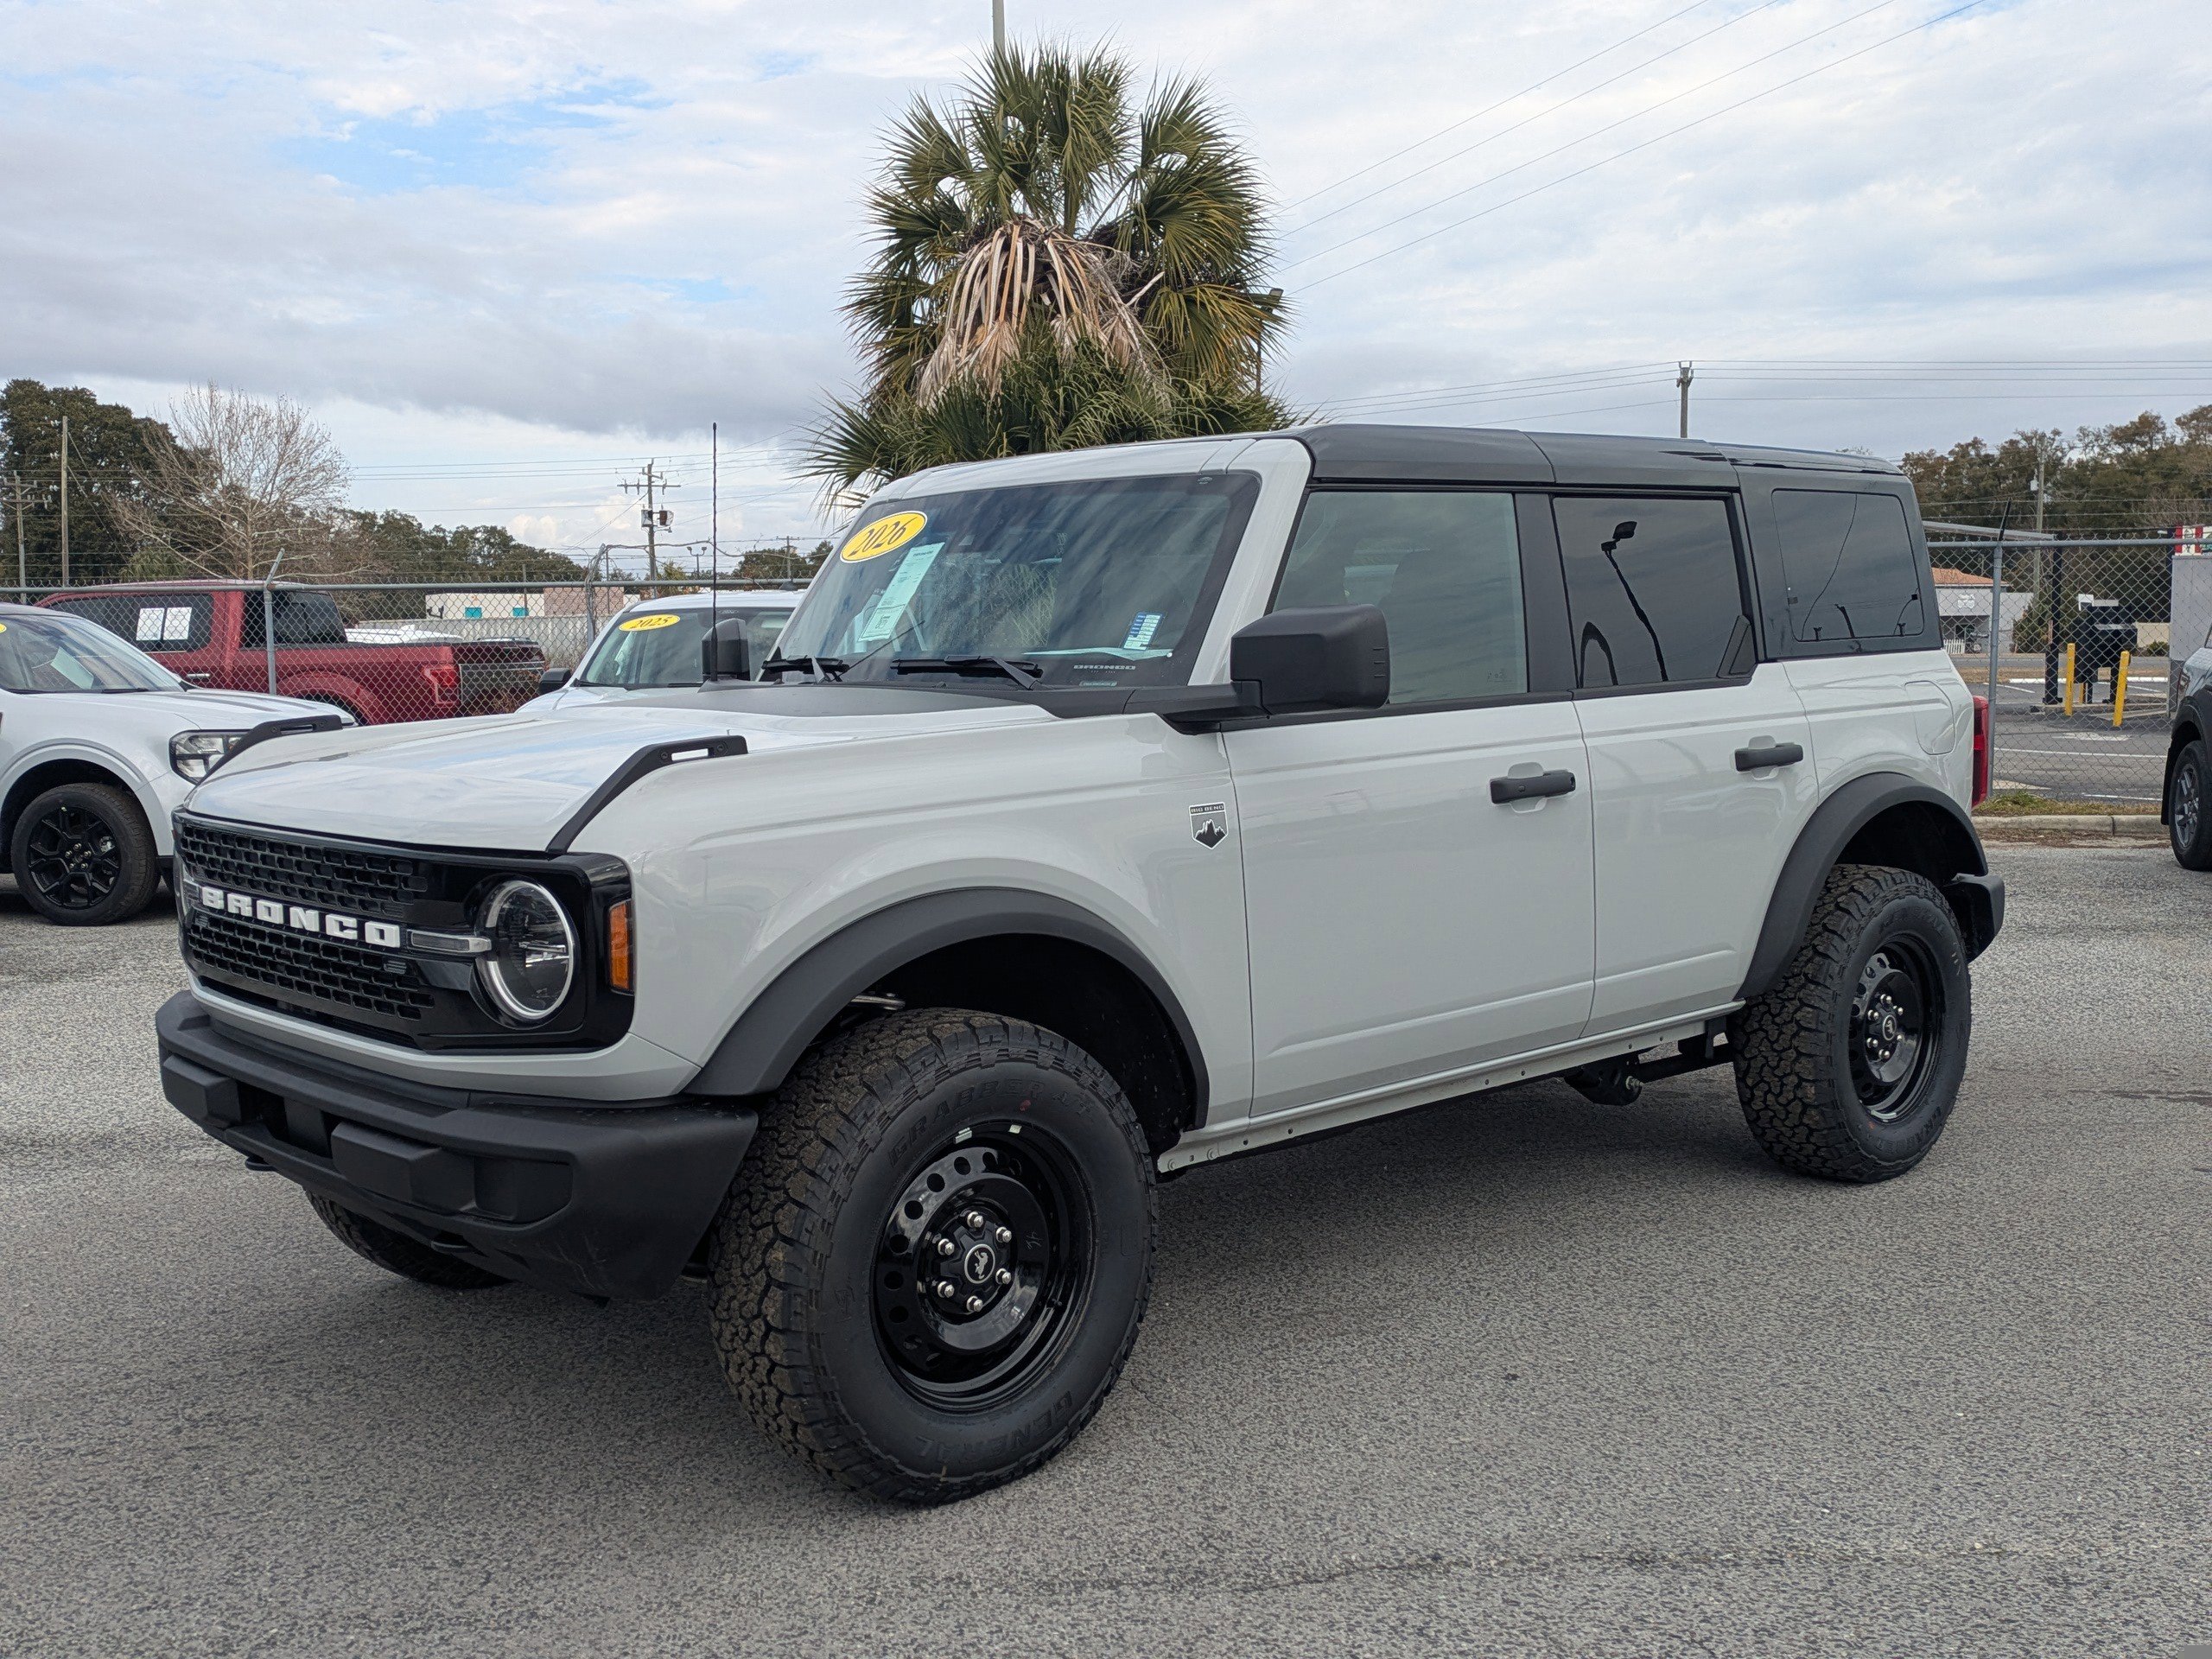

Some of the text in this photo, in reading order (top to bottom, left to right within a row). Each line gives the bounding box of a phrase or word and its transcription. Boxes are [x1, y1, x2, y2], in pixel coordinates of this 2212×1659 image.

[847, 516, 918, 557] 2026
[629, 615, 674, 630] 2025
[201, 886, 401, 949] BRONCO
[888, 1078, 1046, 1167] GRABBER
[914, 1389, 1074, 1464] GENERAL
